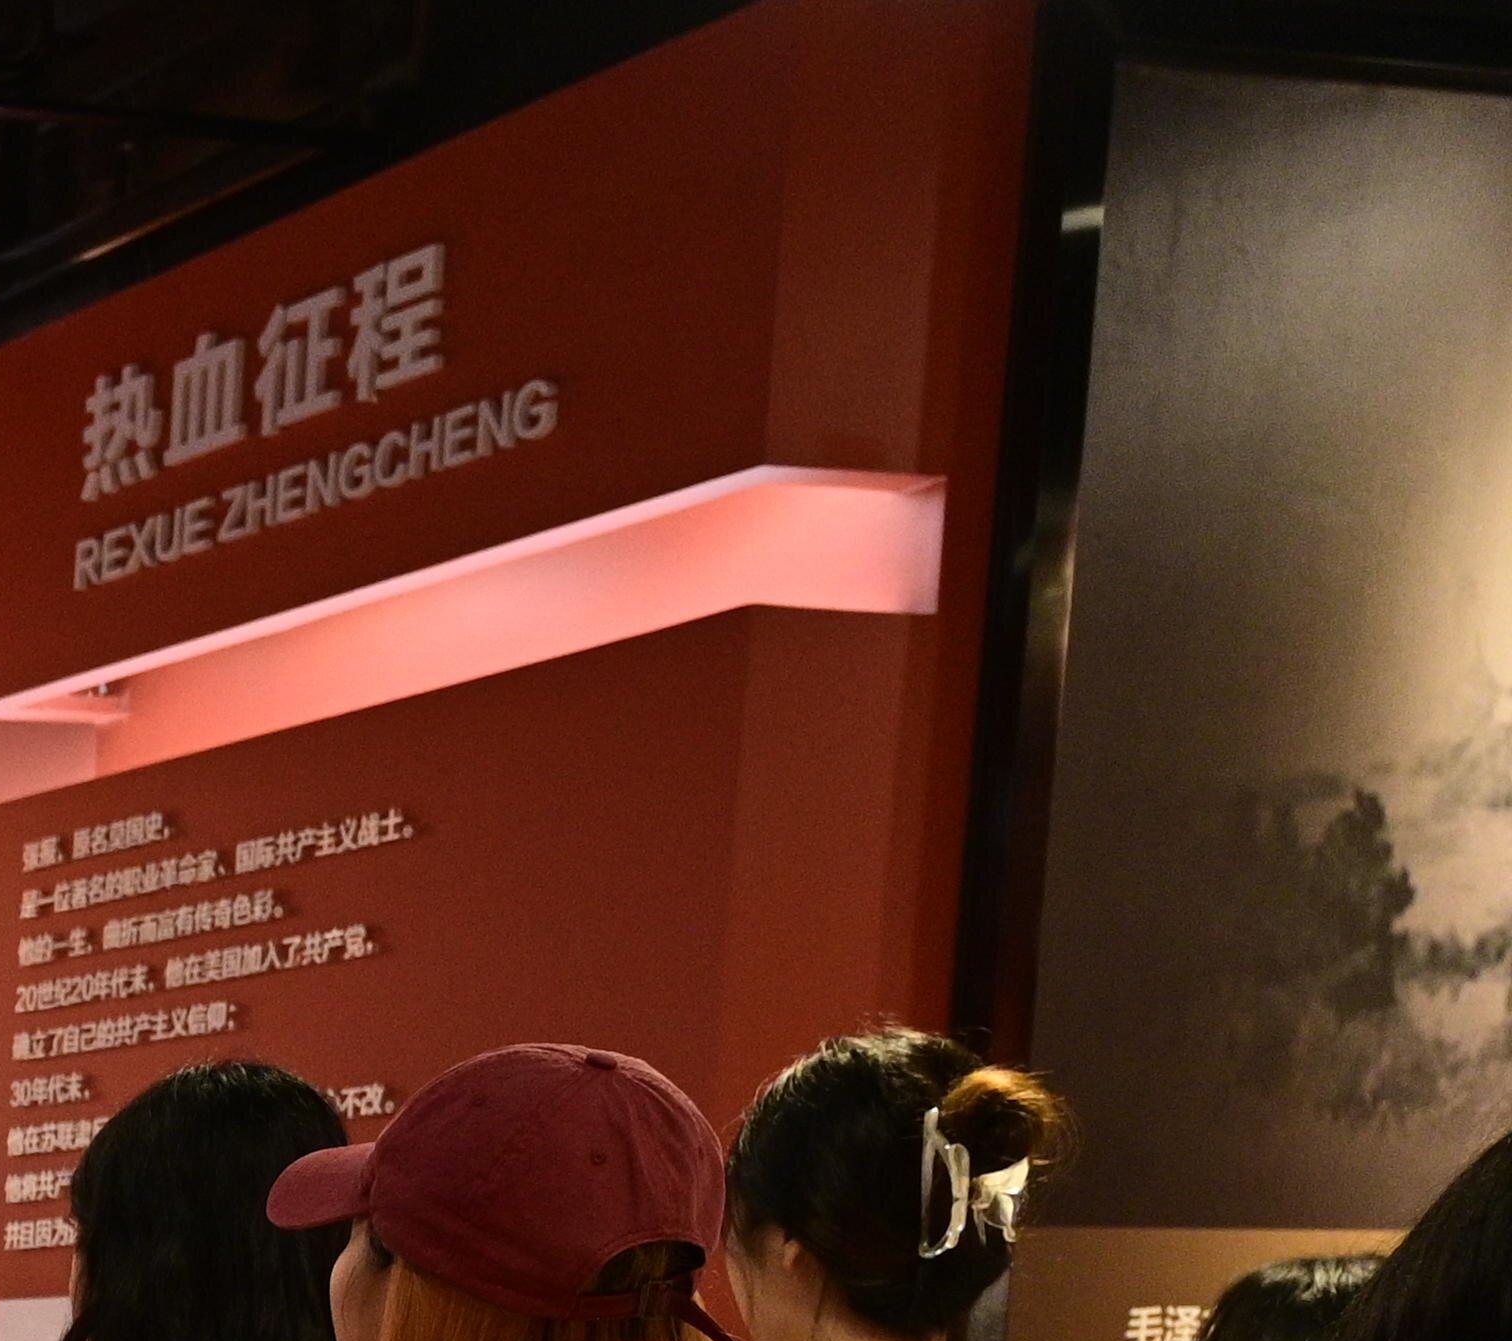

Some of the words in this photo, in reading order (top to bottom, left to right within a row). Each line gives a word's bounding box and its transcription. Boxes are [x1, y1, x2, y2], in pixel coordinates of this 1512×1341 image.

[73, 497, 215, 591] REXUE
[216, 378, 559, 544] ZHENGCHENG
[80, 242, 446, 502] 热血征程
